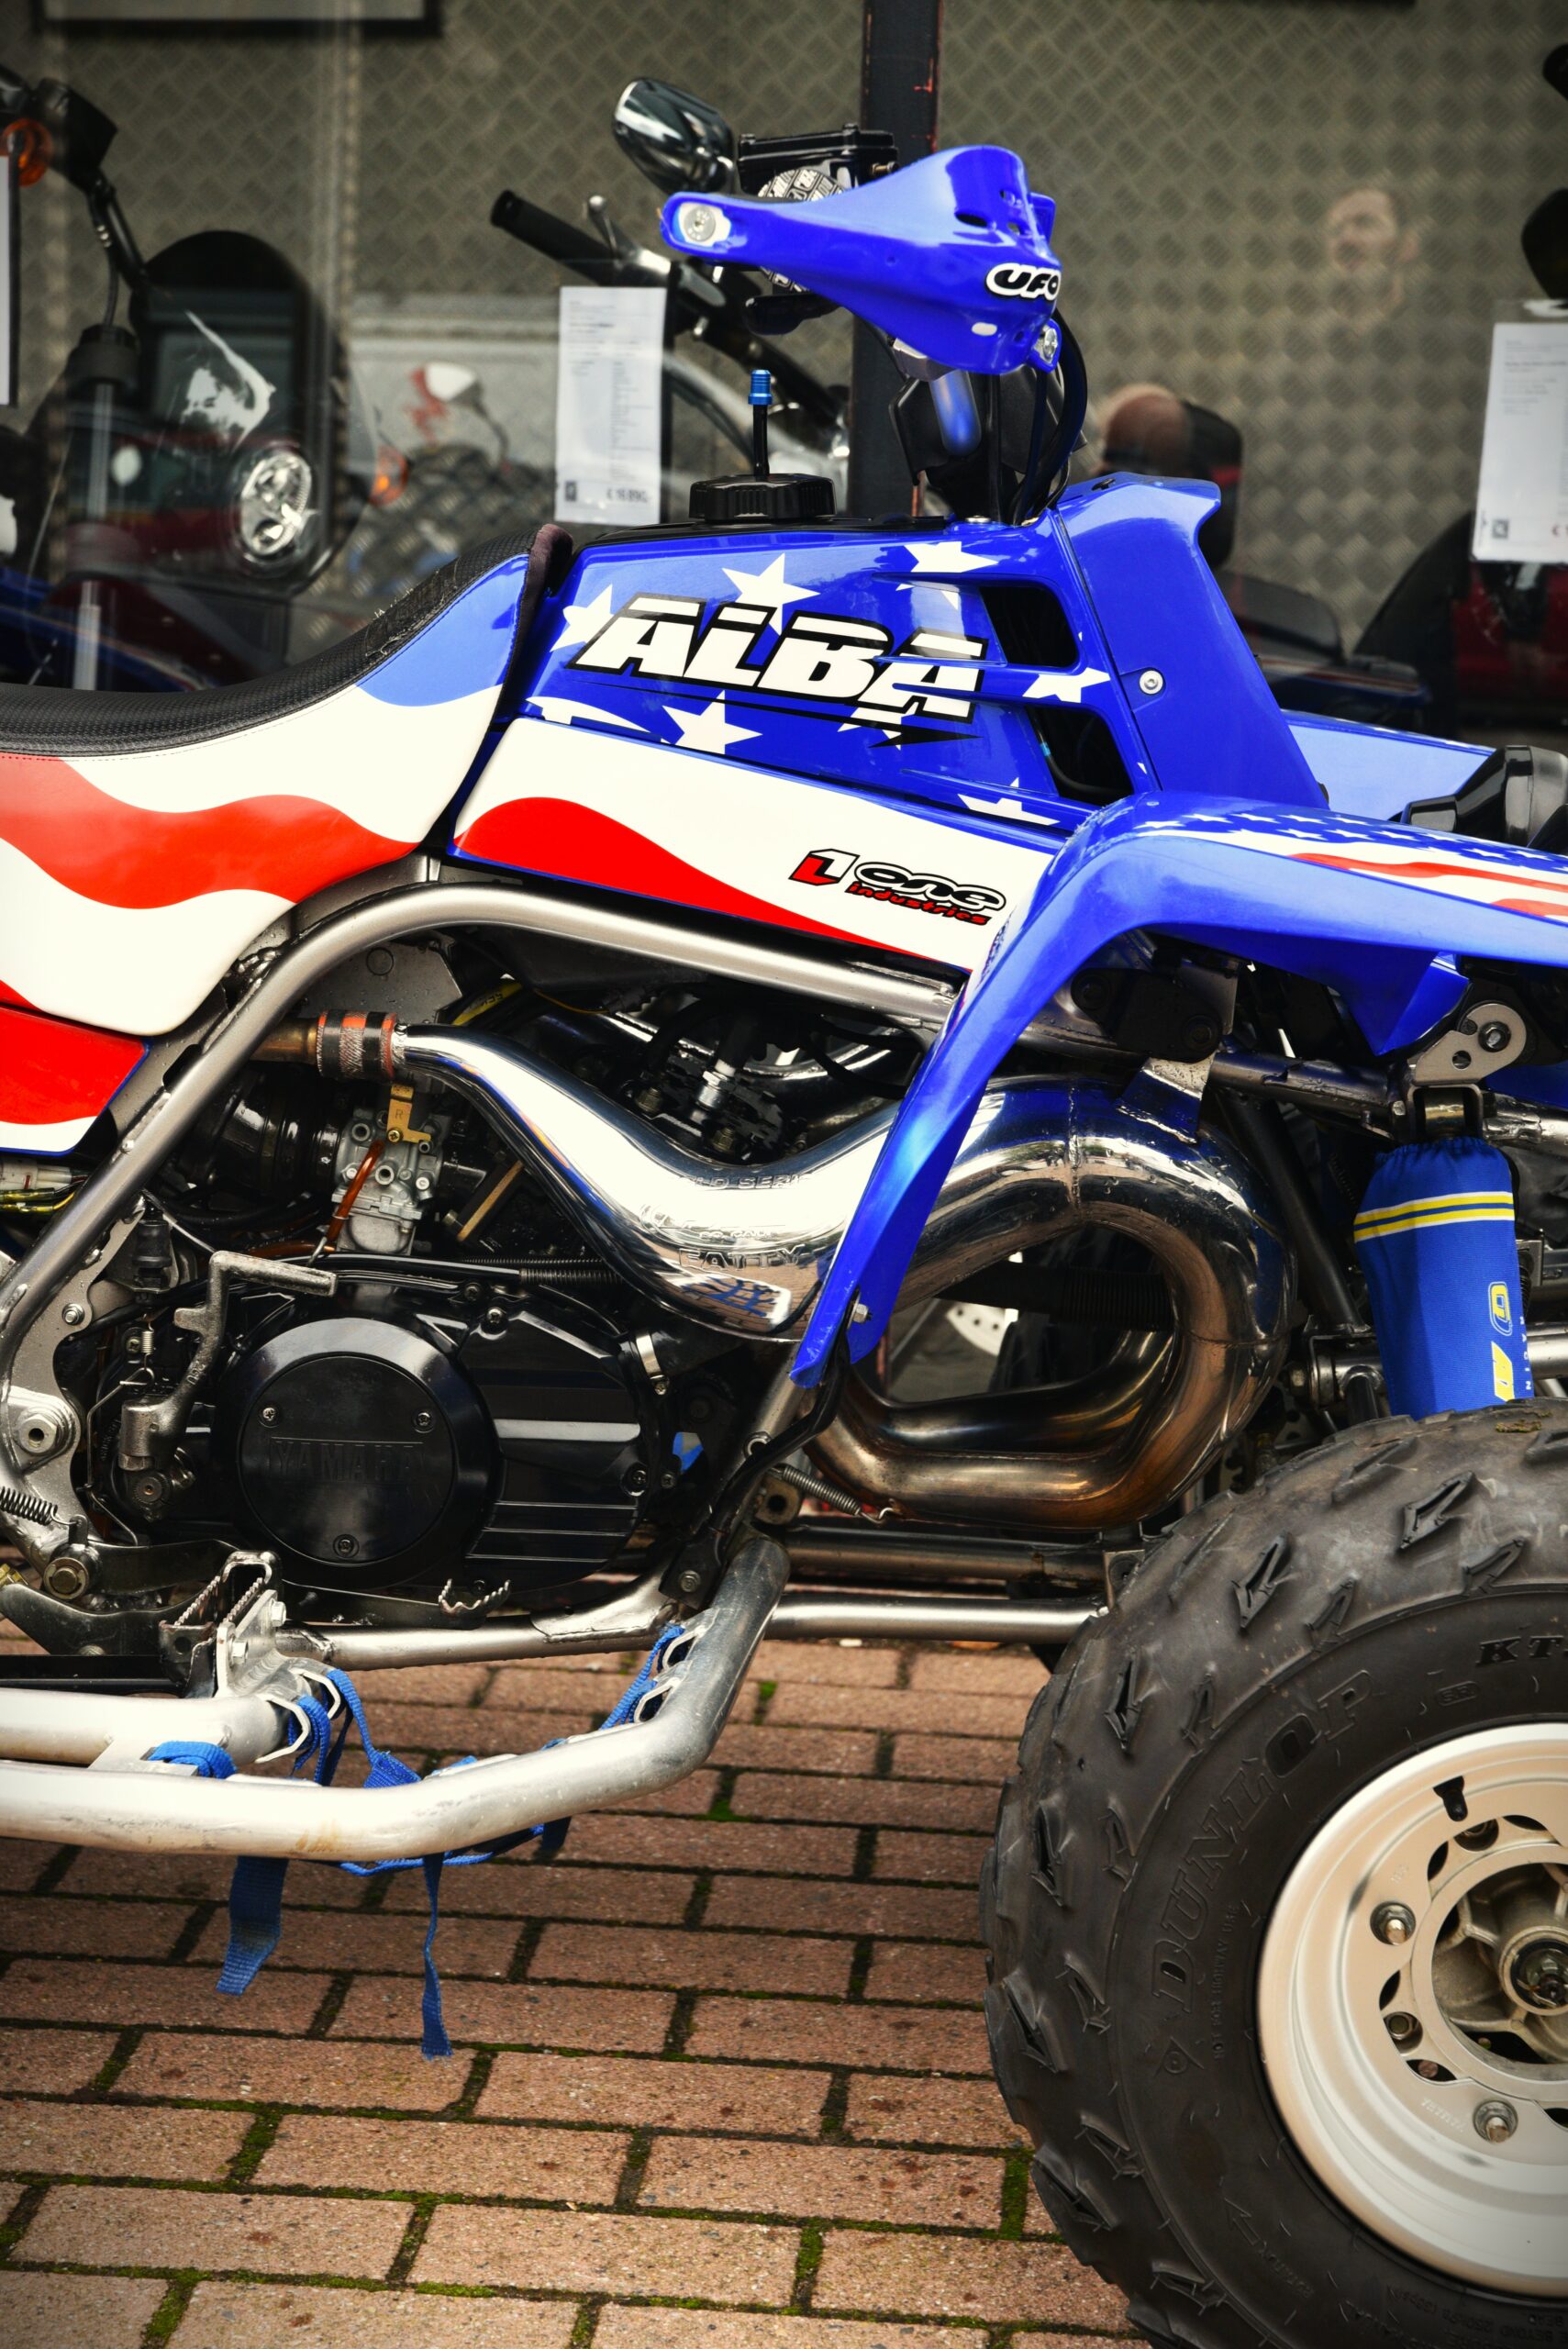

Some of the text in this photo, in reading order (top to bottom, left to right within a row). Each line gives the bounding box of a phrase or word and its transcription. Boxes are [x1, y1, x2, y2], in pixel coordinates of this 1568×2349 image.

[989, 265, 1060, 298] UFO
[564, 592, 989, 725] ALBA
[845, 881, 992, 926] industries
[854, 862, 1006, 911] one
[272, 1441, 421, 1482] YAMAHA
[1151, 1669, 1374, 2013] DUNLOP
